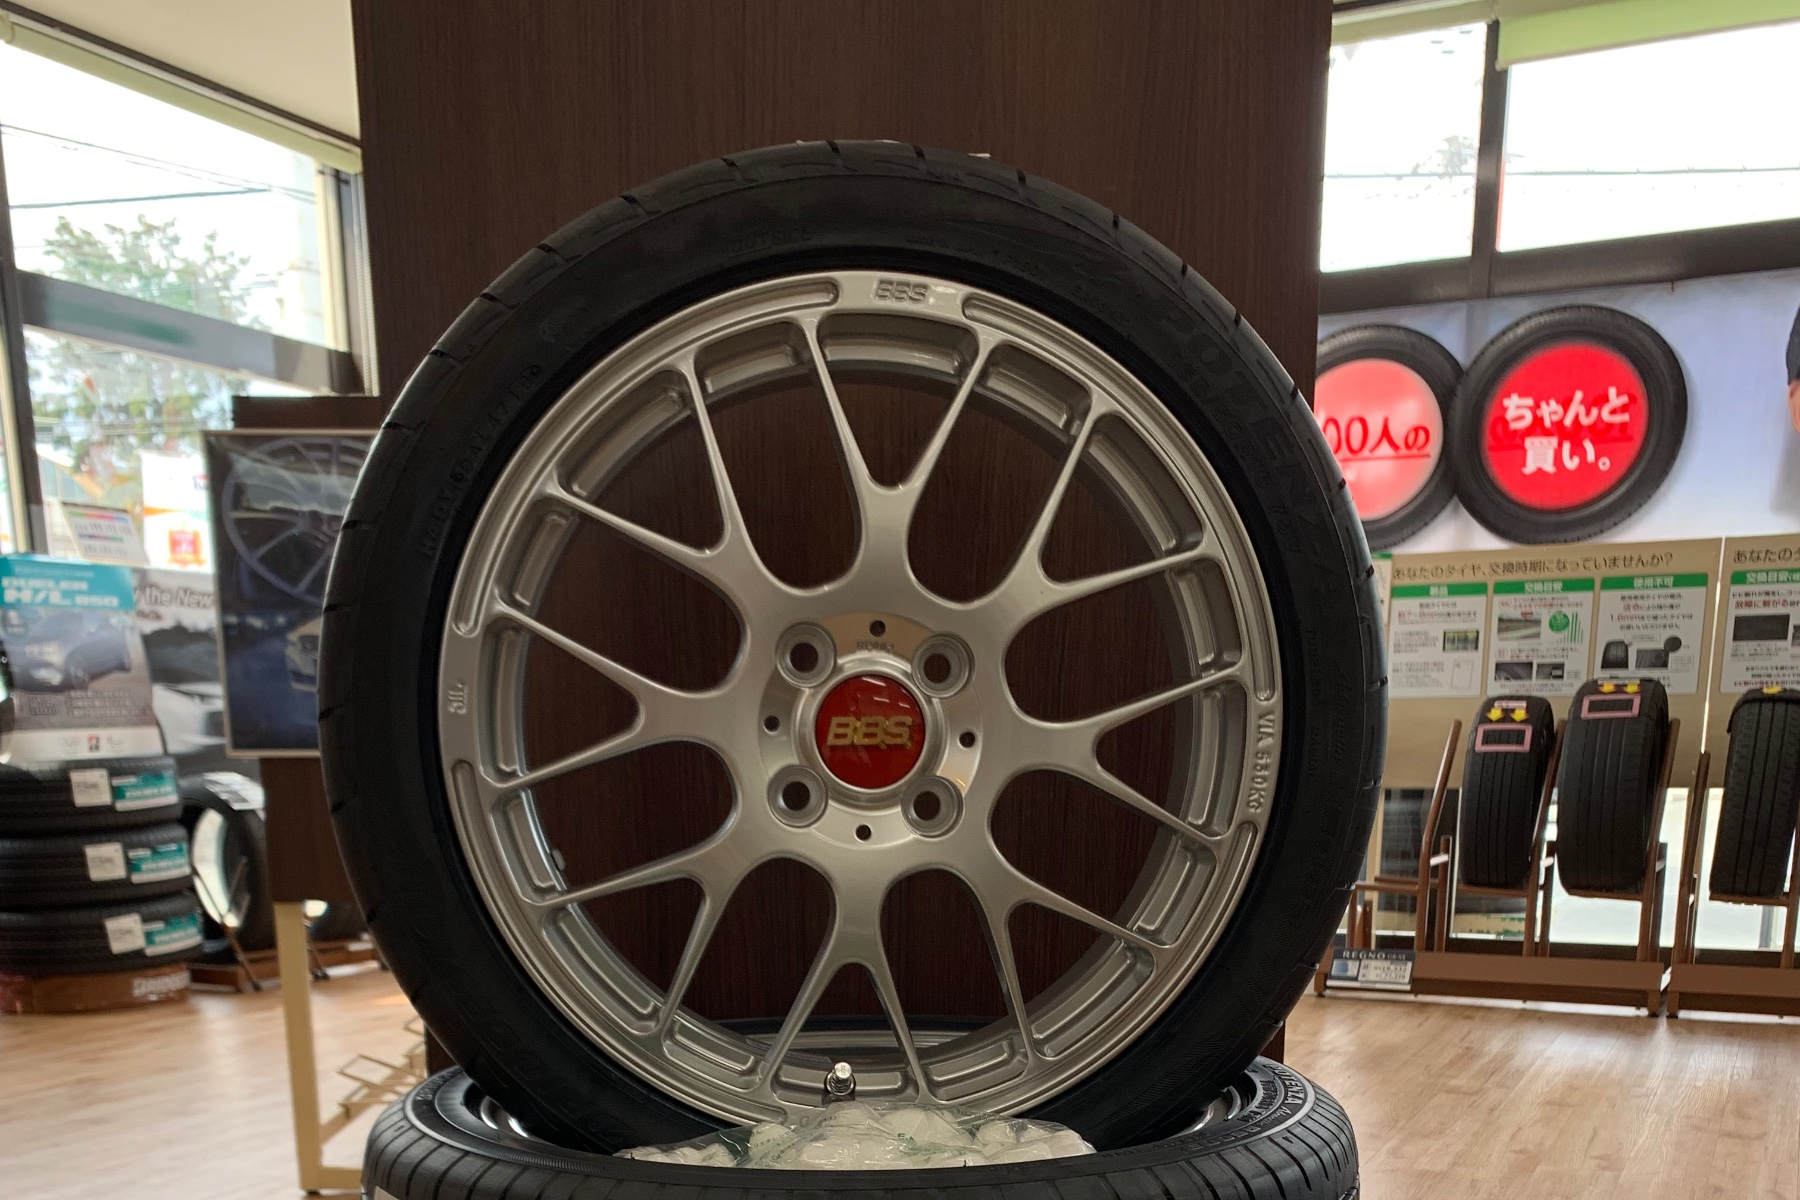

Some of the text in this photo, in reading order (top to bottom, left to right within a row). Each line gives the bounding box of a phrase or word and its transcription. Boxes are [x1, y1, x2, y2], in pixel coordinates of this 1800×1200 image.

[1503, 386, 1630, 430] ちゃんと
[1522, 436, 1611, 475] 買い。
[826, 716, 913, 746] BBS
